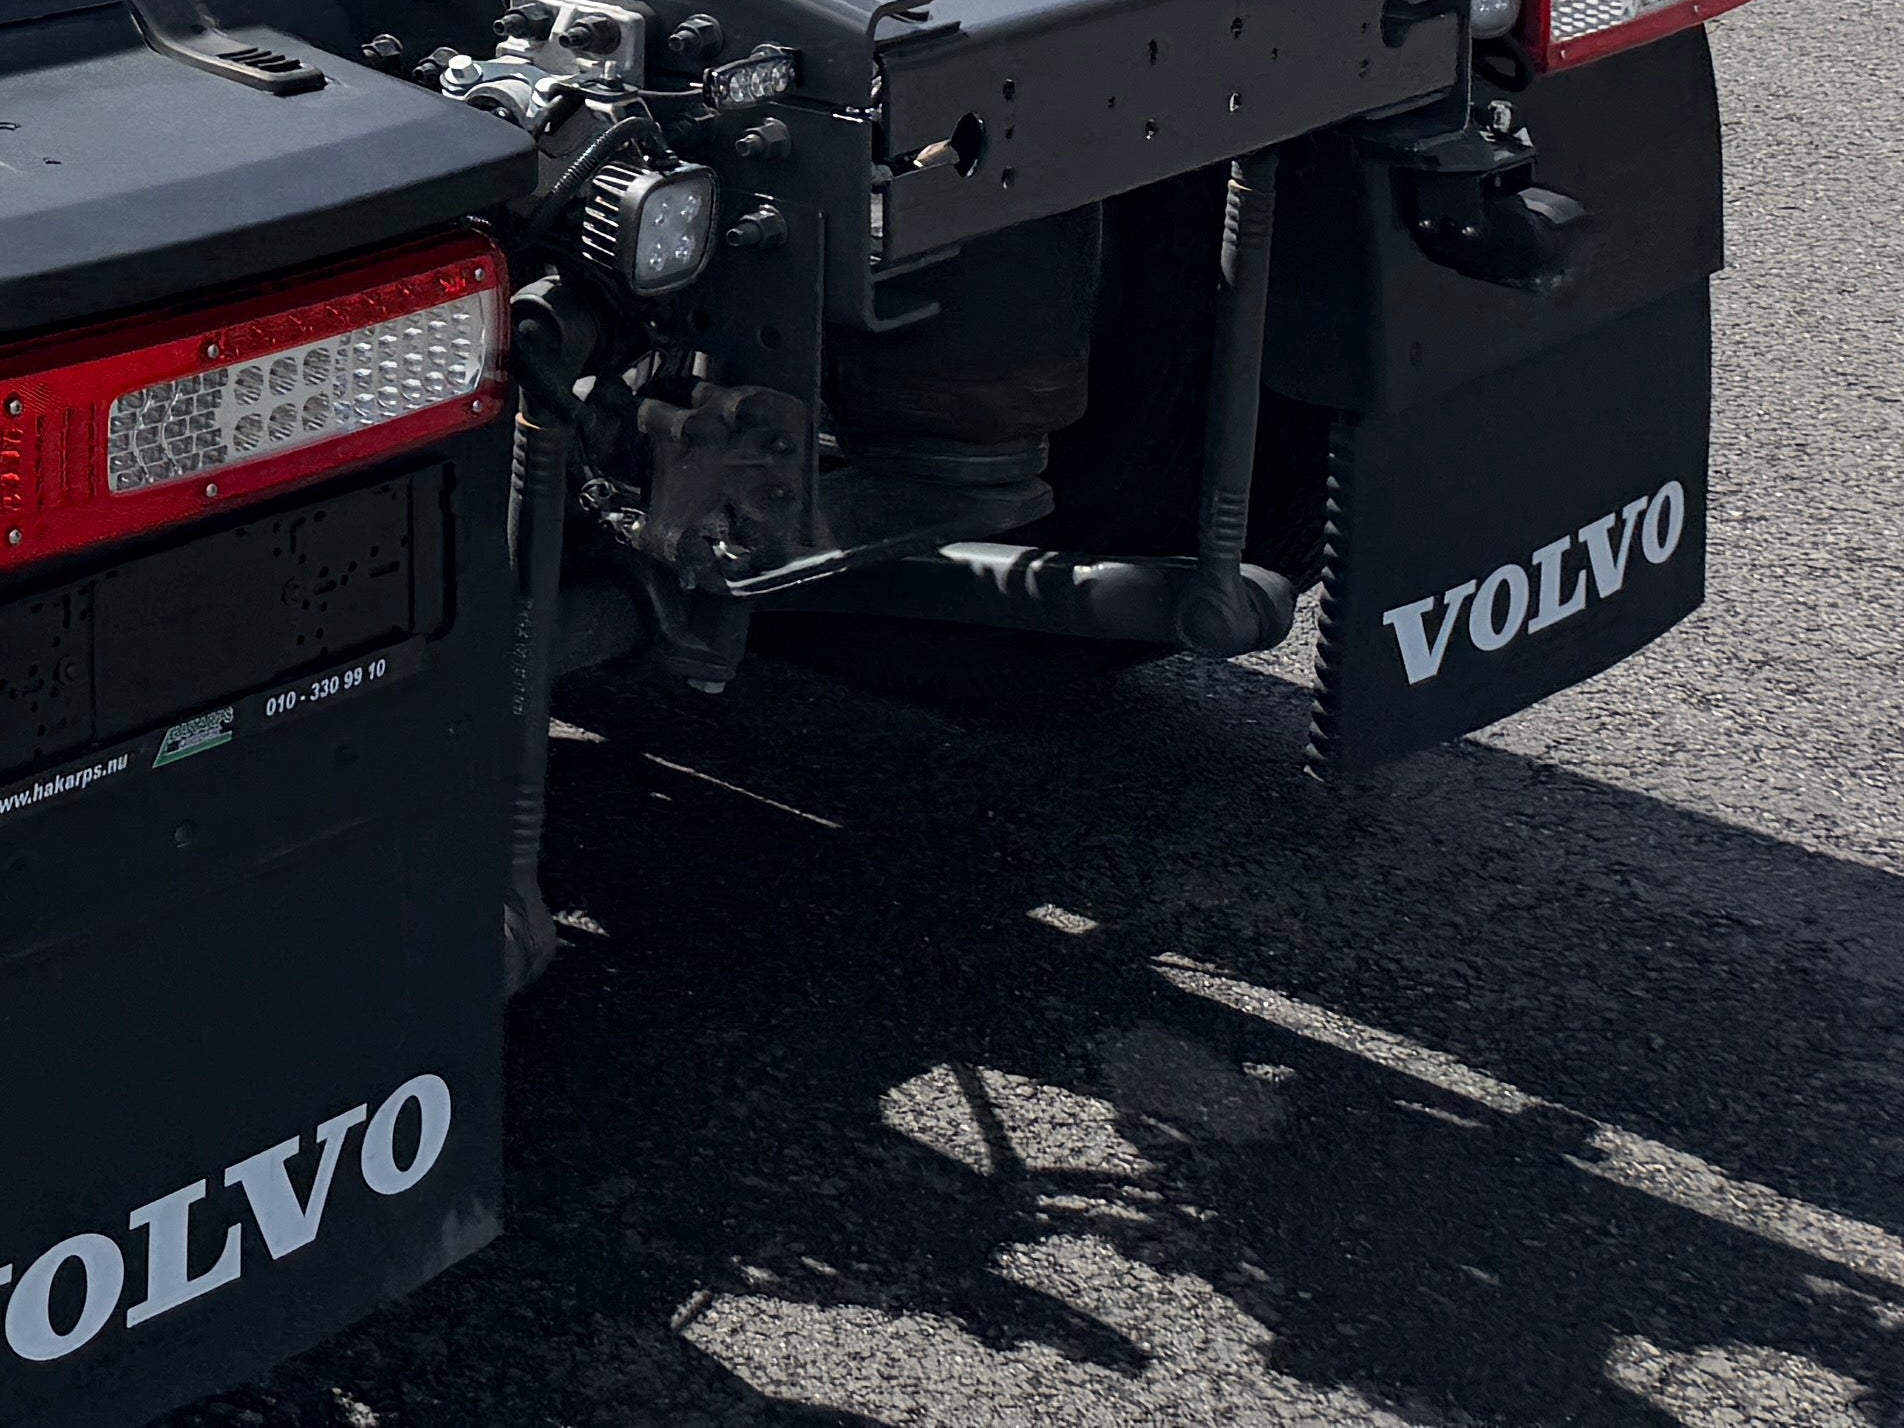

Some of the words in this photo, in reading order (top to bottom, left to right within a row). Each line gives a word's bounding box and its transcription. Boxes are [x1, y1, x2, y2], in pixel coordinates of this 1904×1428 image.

[1382, 480, 1686, 686] VOLVO
[265, 689, 297, 717] 010
[309, 677, 340, 704] 330
[344, 665, 364, 690] 99
[368, 657, 387, 682] 10
